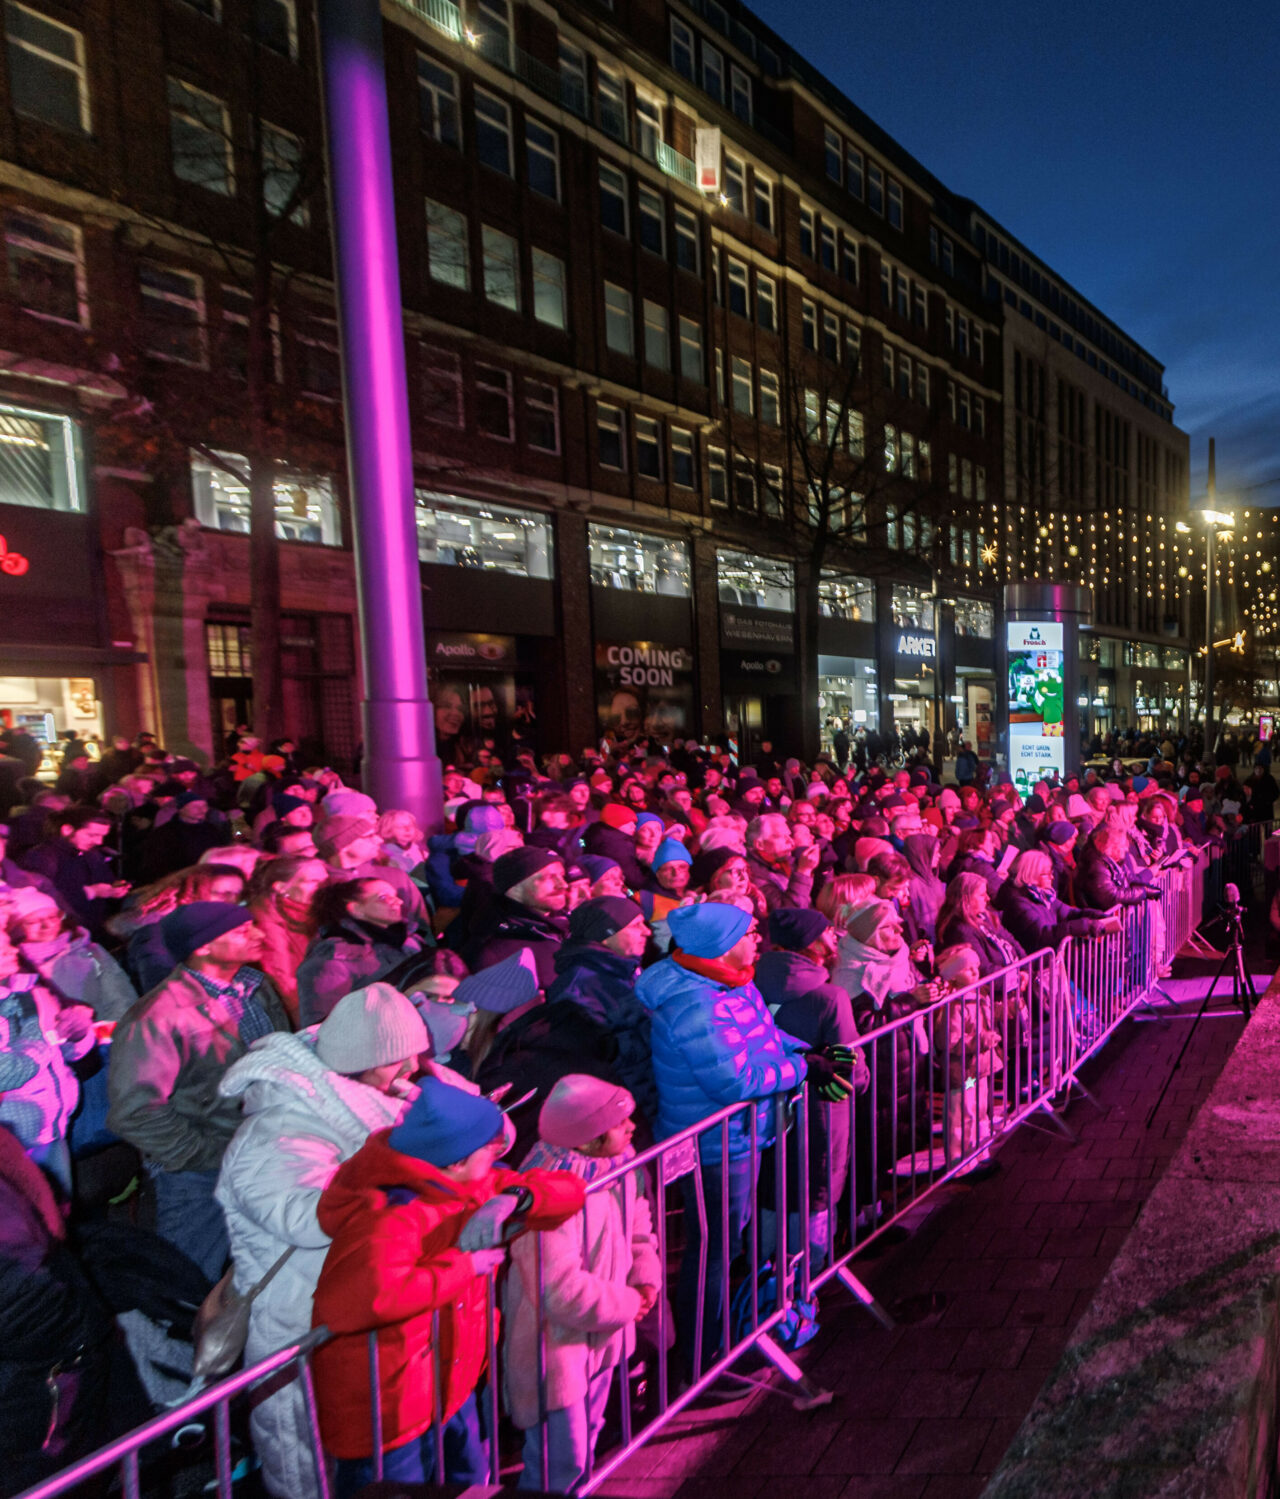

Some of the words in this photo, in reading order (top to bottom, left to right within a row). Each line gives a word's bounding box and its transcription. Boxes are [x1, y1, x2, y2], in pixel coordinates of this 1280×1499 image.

[435, 642, 476, 657] Apollo
[898, 635, 936, 657] ARKET
[607, 646, 683, 669] COMING
[740, 660, 764, 671] Apollo
[620, 667, 673, 686] SOON
